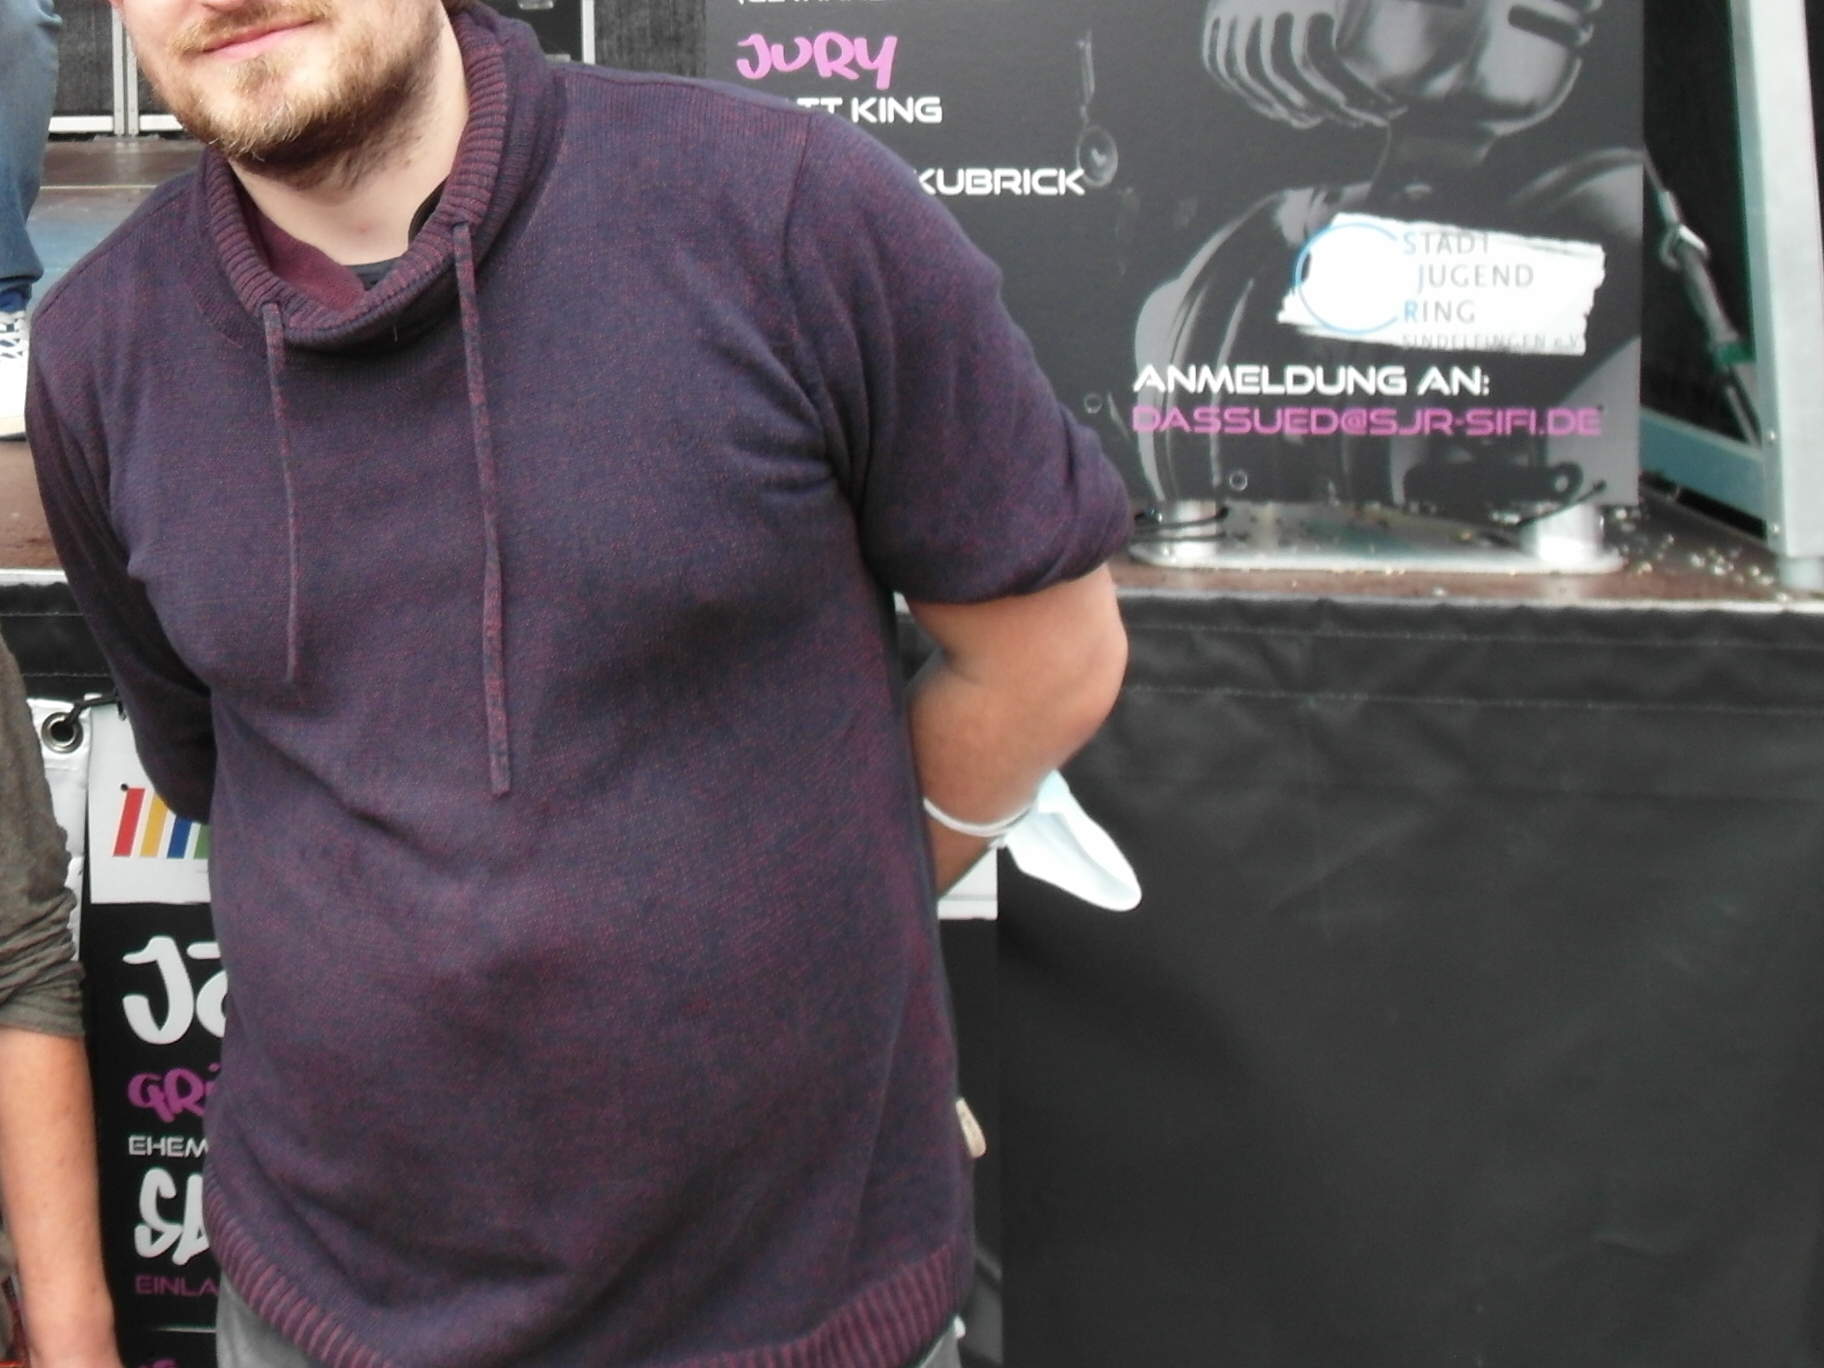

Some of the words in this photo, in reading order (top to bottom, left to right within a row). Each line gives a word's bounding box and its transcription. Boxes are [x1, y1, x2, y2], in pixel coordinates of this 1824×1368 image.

[851, 96, 943, 123] KING
[1403, 232, 1490, 255] STADT
[1416, 264, 1534, 295] JUGEND
[1404, 300, 1476, 324] RING
[1132, 364, 1408, 396] ANMELDUNG
[1417, 366, 1490, 396] AN:
